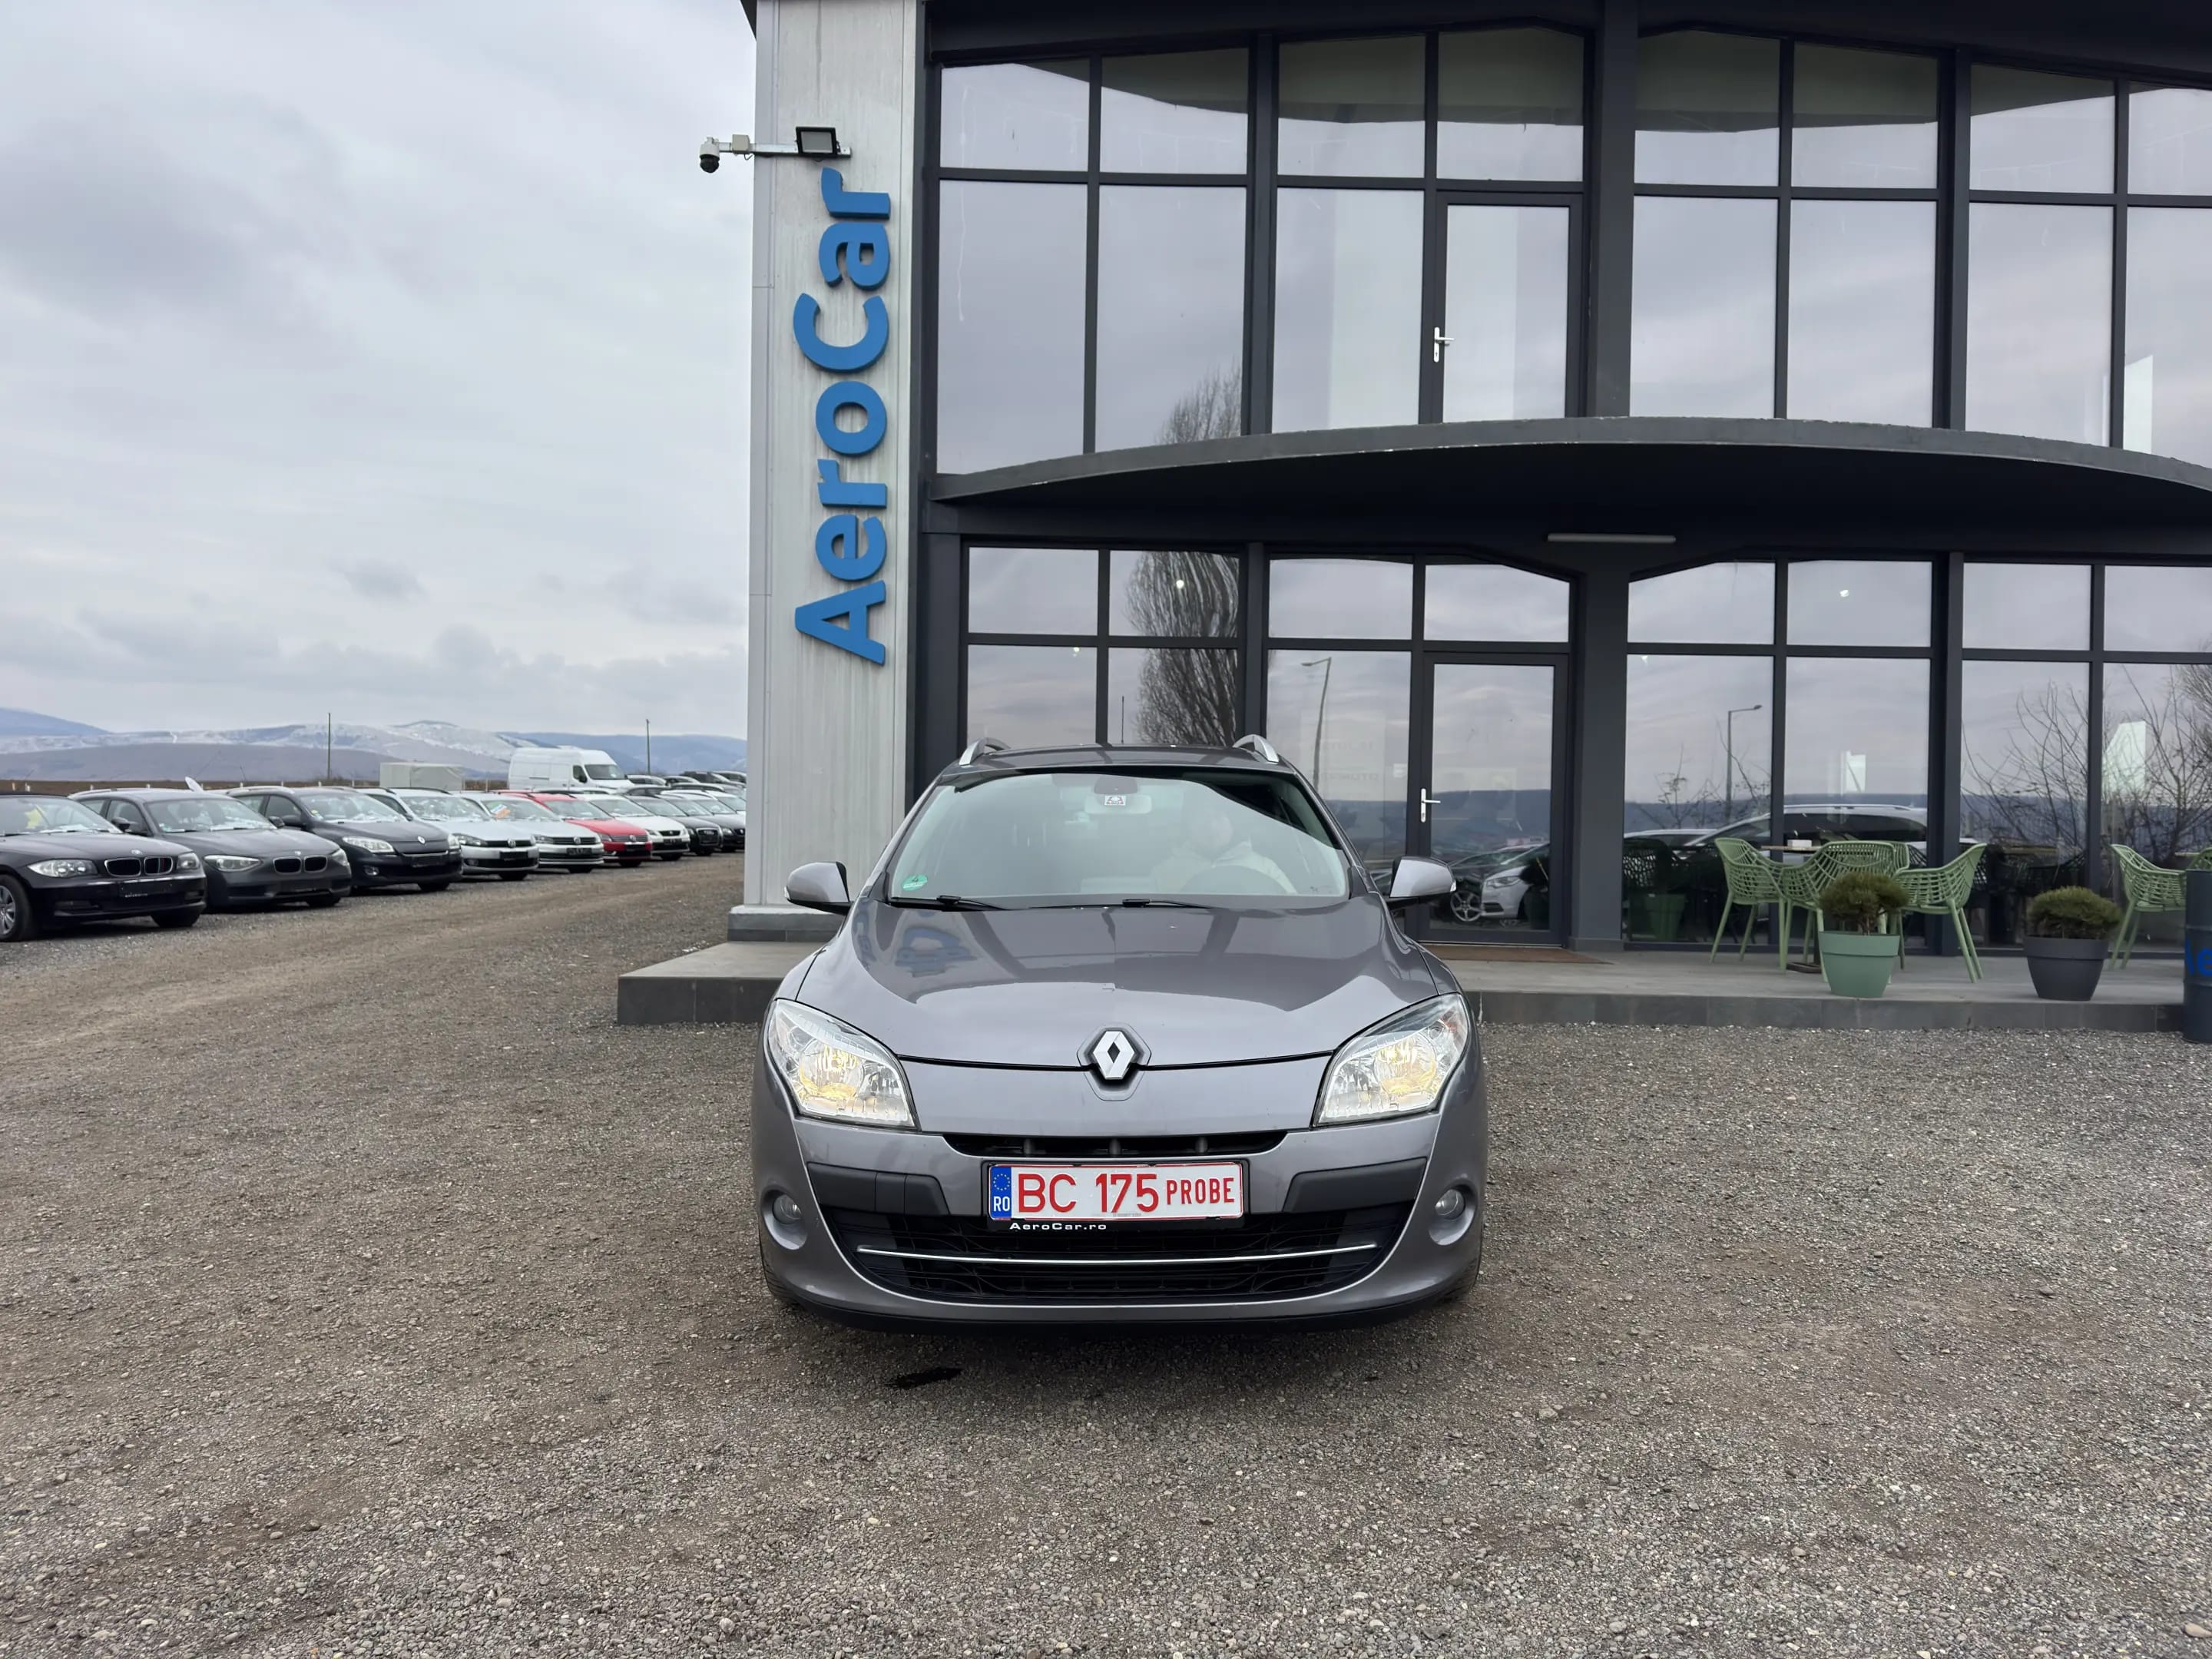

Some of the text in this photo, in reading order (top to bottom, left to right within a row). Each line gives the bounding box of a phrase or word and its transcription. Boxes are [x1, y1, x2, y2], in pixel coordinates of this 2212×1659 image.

[793, 167, 891, 665] AeroCar
[993, 1173, 1235, 1213] RO BC 175 PROBE
[1009, 1222, 1107, 1230] AeroCar.ro
